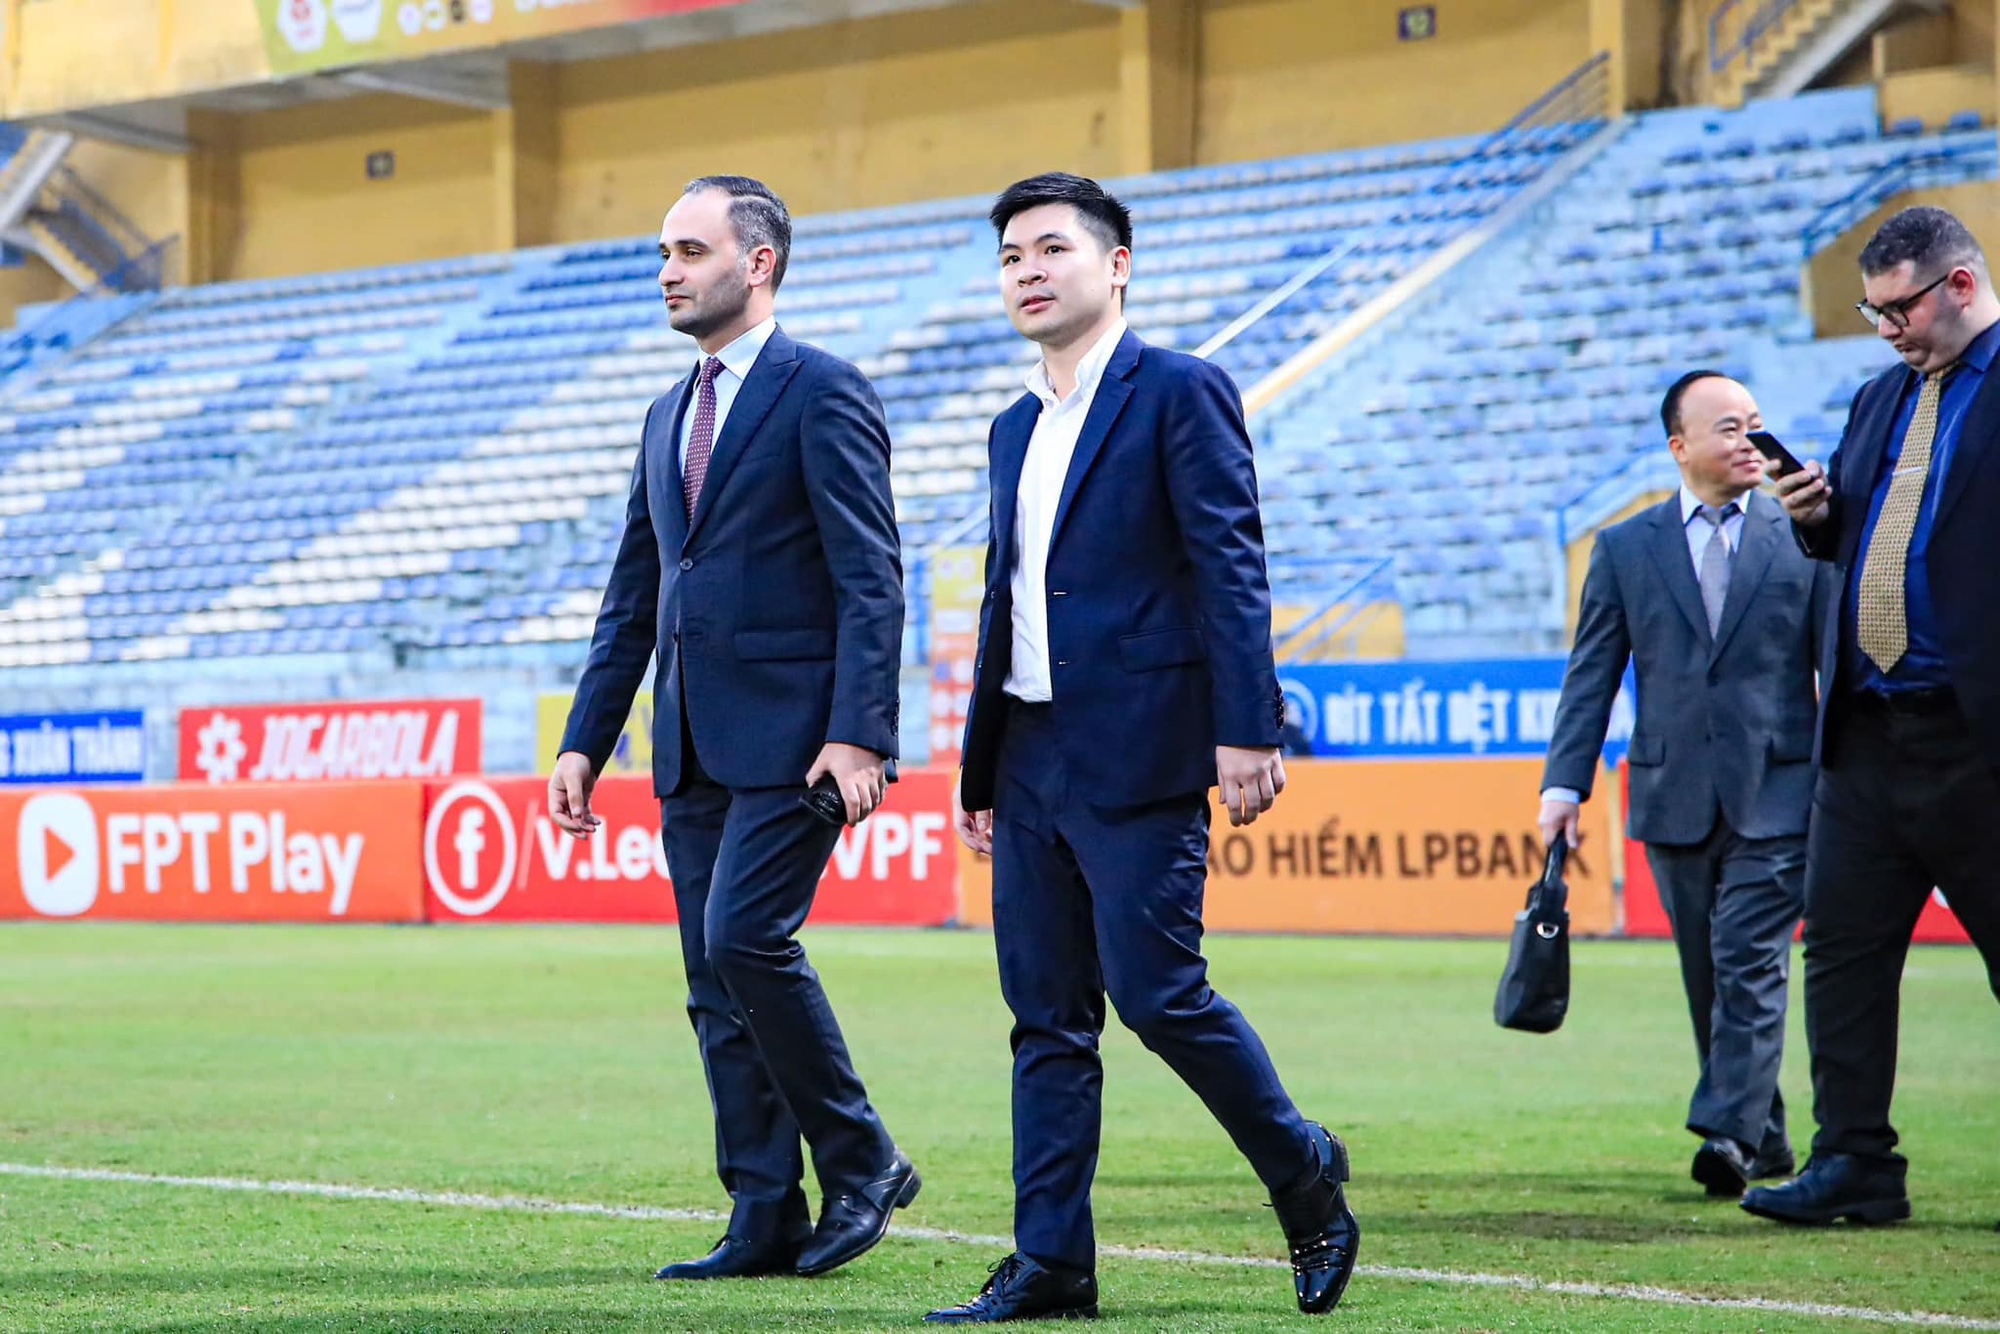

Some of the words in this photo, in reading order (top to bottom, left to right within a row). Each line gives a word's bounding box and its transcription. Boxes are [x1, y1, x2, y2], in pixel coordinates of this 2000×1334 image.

[250, 709, 459, 780] JOGARBOLA
[106, 813, 221, 894] FPT
[228, 811, 365, 916] Play
[1397, 830, 1592, 879] LPBANK
